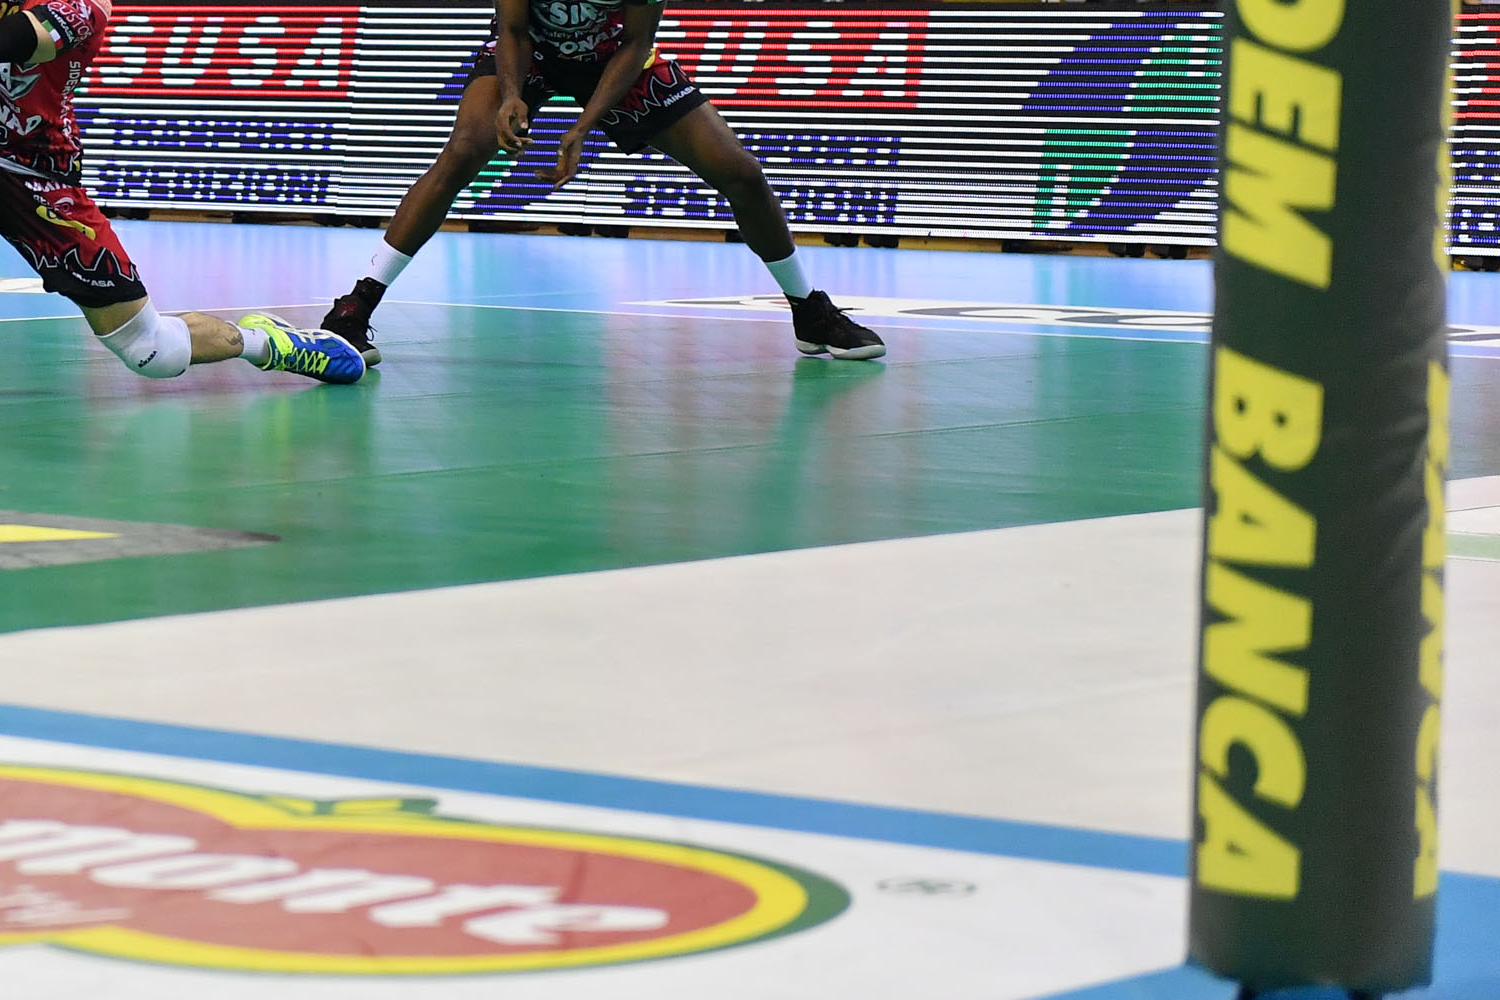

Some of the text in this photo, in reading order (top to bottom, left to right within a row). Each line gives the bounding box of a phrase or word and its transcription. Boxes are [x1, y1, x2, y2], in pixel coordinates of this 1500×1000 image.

[101, 13, 345, 88] SUSA
[549, 1, 599, 25] SIR
[1198, 345, 1325, 901] BANCA
